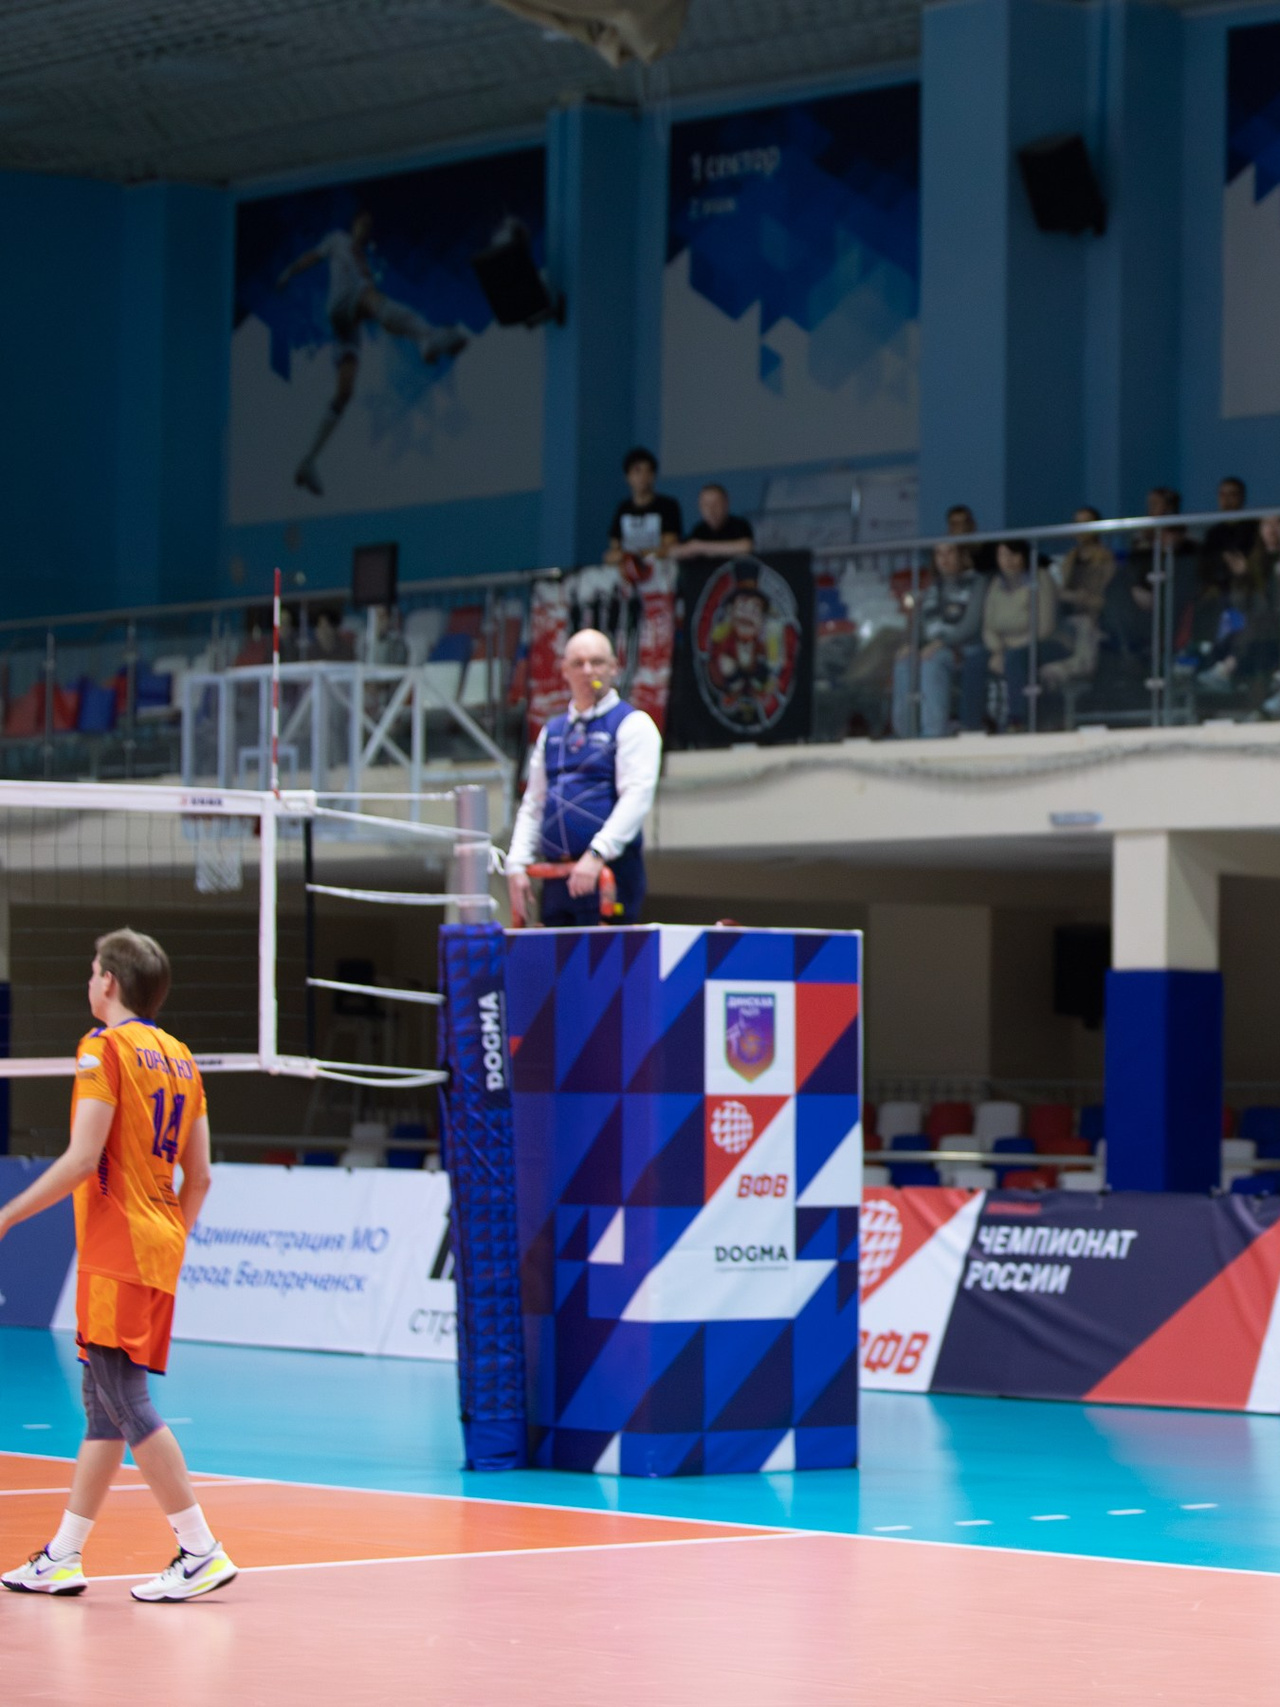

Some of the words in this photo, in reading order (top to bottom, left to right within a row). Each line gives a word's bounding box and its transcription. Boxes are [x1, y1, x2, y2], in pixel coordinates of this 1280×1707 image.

[478, 991, 504, 1092] DOGMA
[149, 1087, 185, 1164] 14
[737, 1174, 788, 1198] ВФВ
[351, 1226, 389, 1253] МО
[715, 1245, 788, 1262] DOGMA
[979, 1225, 1138, 1260] ЧЕМПИОНАТ
[181, 1263, 231, 1290] ород
[964, 1261, 1070, 1294] РОССИИ
[861, 1330, 929, 1375] ФВ
